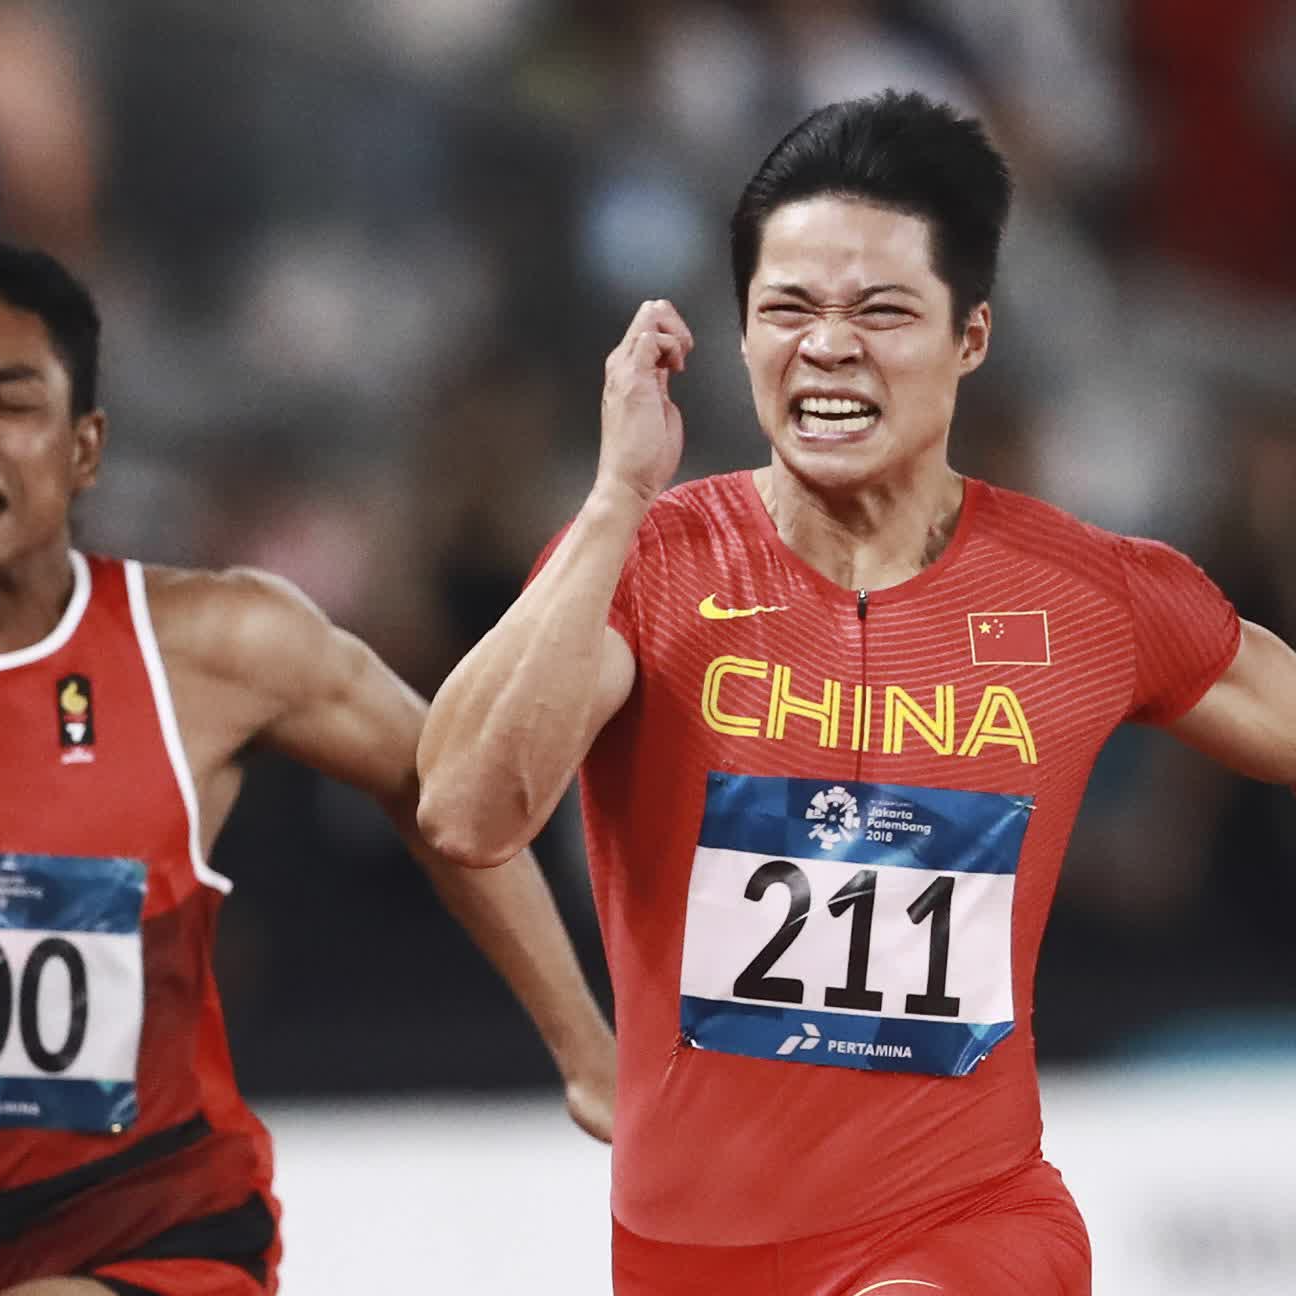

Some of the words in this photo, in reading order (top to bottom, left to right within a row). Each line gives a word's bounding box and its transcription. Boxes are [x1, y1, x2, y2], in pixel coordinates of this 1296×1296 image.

[702, 655, 1038, 764] CHINA
[868, 806, 913, 820] Jakarta
[867, 817, 932, 835] Palembang
[865, 830, 893, 842] 2018
[732, 860, 960, 1018] 211
[827, 1039, 913, 1058] PERTAMINA
